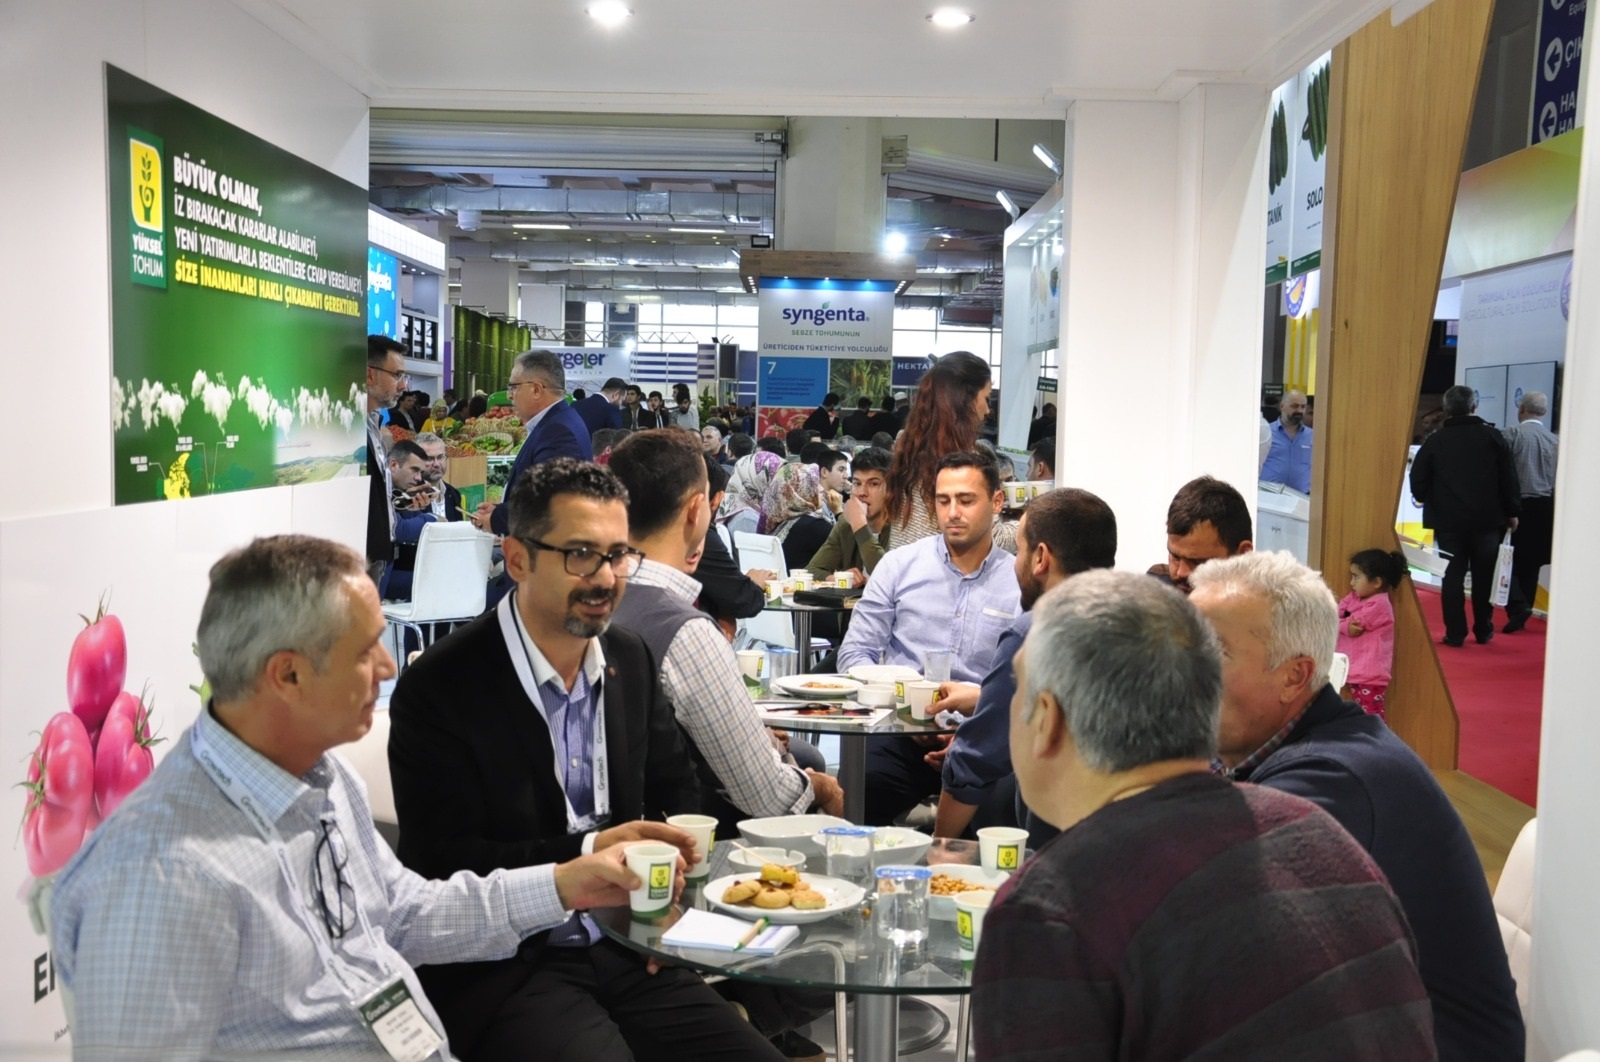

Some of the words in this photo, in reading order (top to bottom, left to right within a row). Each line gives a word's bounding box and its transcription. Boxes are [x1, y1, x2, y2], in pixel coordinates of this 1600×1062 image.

[173, 152, 217, 195] BÜYÜK
[219, 174, 263, 217] OLMAK,
[1306, 186, 1323, 211] SOLO
[174, 187, 185, 217] İZ
[186, 197, 238, 234] BIRAKACAK
[238, 214, 278, 246] KARARLAR
[278, 229, 318, 261] ALABİLMEYİ,
[132, 231, 163, 257] YÜKSEL
[132, 254, 164, 278] TOHUM
[174, 226, 198, 253] YENİ
[199, 233, 258, 268] YATIRIMLARLA
[258, 250, 306, 280] BEKLENTİLERE
[307, 264, 328, 286] CEVAP
[328, 270, 364, 297] VEREBİLMEYİ,
[175, 254, 199, 284] SİZE
[200, 259, 257, 297] İNANANLARI
[259, 278, 283, 302] HAKLI
[284, 285, 323, 309] ÇIKARMAYI
[782, 306, 866, 326] syngenta
[763, 342, 804, 351] ÜRETİCİDEN
[806, 343, 845, 352] TÜKETİCİYE
[847, 344, 888, 353] YOLCULUĞU
[767, 361, 777, 375] 7
